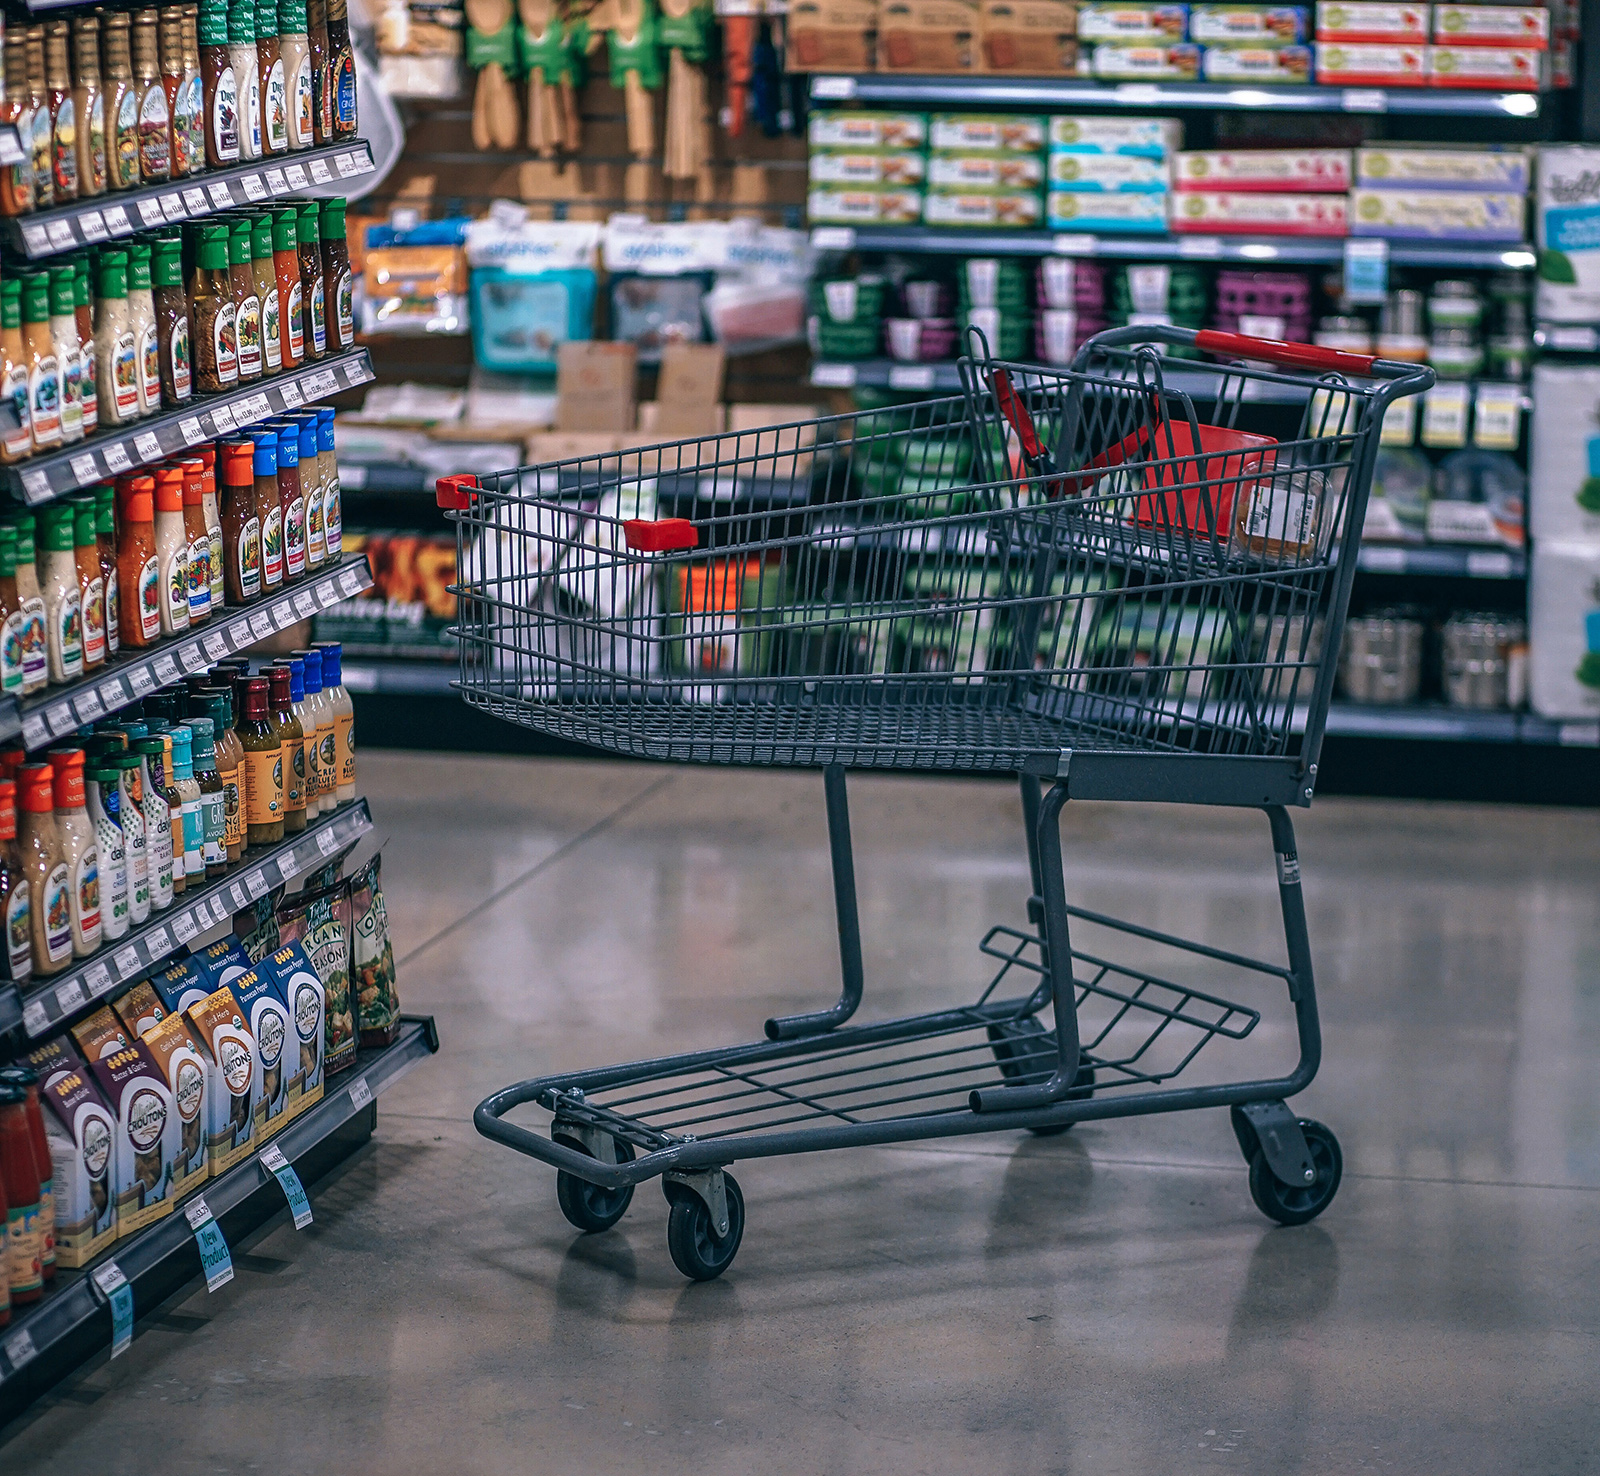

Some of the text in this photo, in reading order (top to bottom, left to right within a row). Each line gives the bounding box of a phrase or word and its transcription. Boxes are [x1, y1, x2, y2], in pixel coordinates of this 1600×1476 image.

[281, 1173, 297, 1189] New
[286, 1189, 307, 1209] Product
[201, 1229, 218, 1248] New
[201, 1244, 229, 1270] Product
